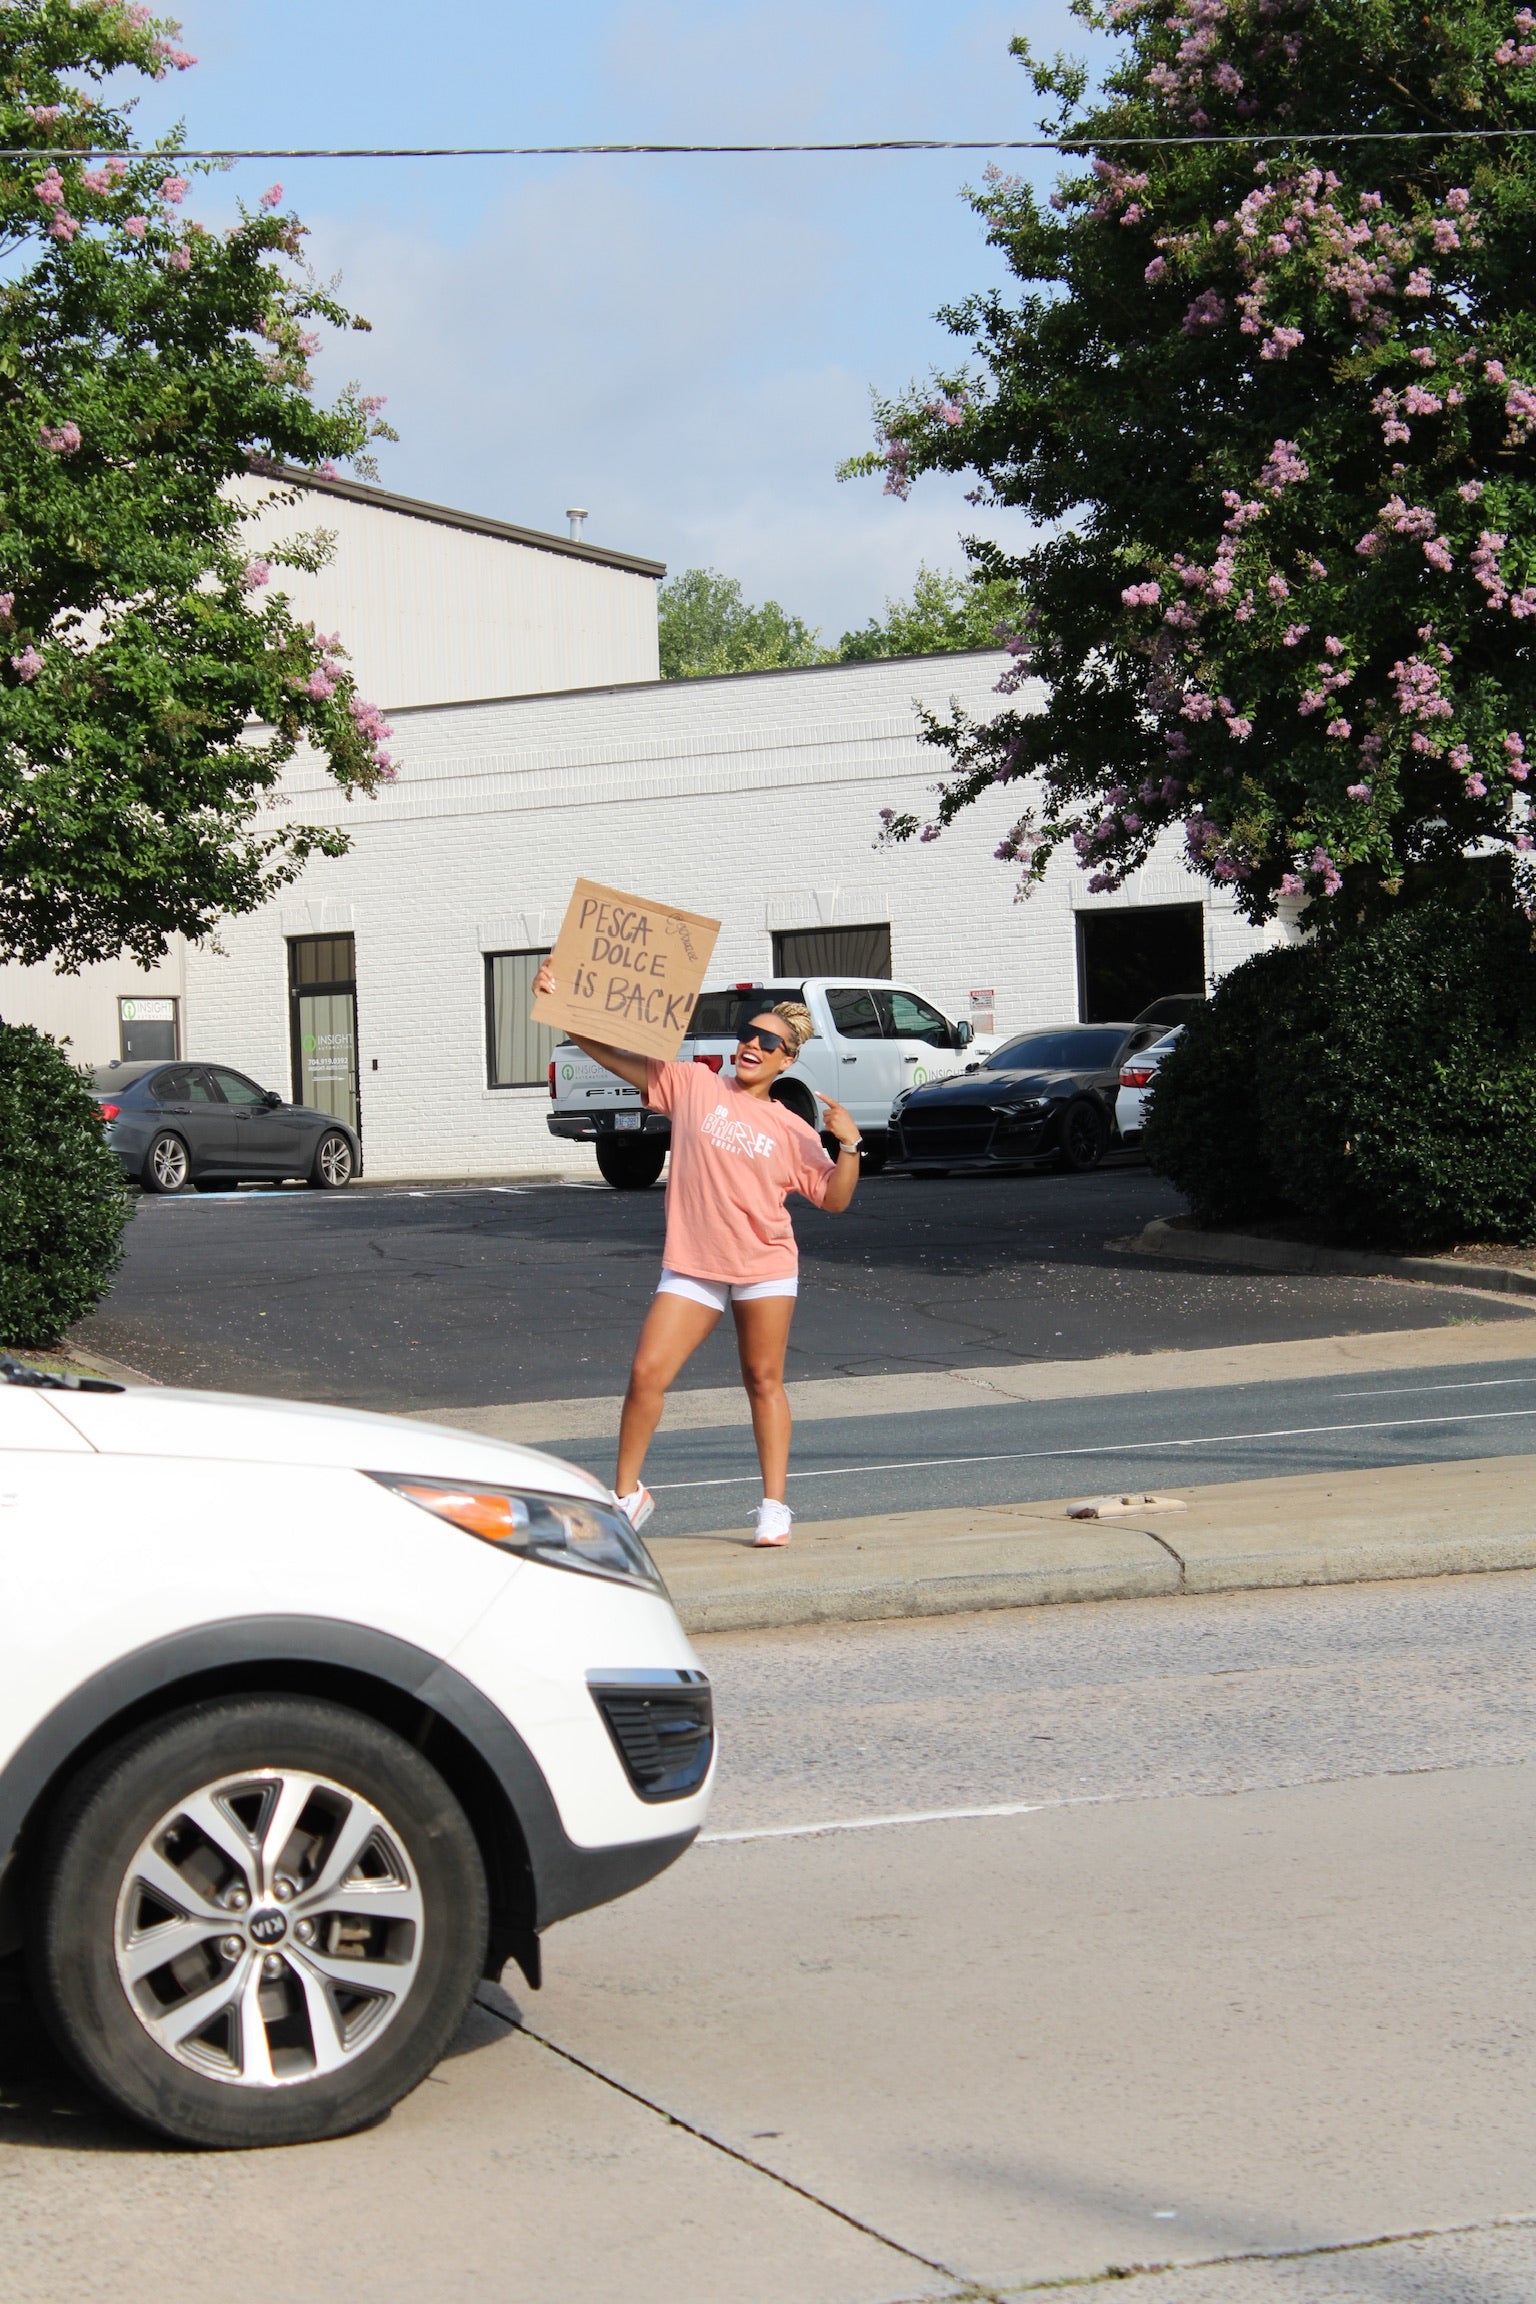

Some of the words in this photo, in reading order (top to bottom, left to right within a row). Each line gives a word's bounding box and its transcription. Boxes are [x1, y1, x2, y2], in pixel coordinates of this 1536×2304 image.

[580, 899, 653, 946] PESCA
[591, 937, 668, 978] DOLCE
[137, 1002, 172, 1013] INSIGHT
[605, 977, 694, 1031] BACK!
[317, 1034, 353, 1046] INSIGHT
[575, 1064, 606, 1075] INSIGH
[586, 1088, 640, 1097] F-15
[251, 1916, 285, 1938] KIA
